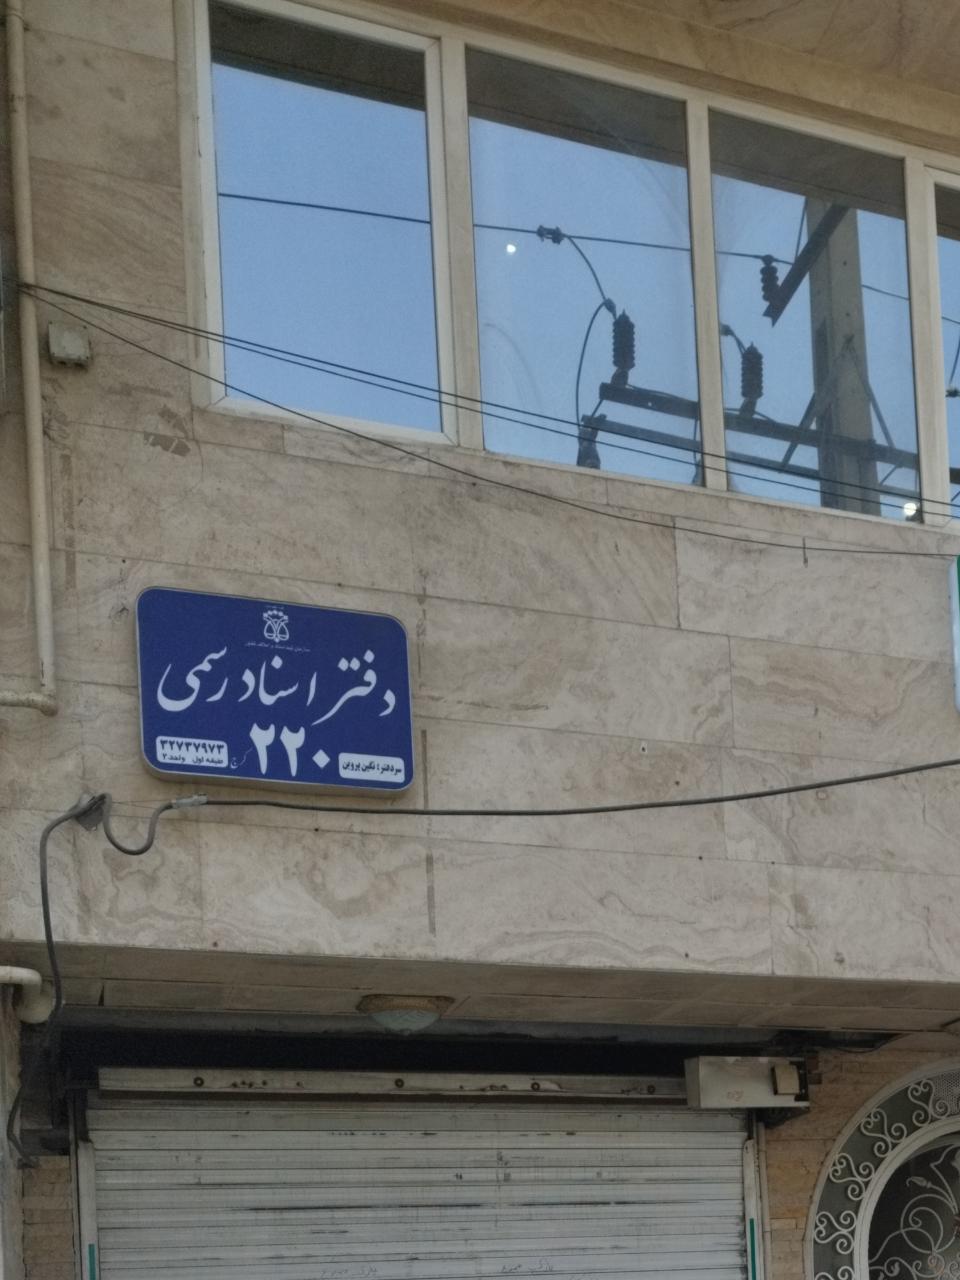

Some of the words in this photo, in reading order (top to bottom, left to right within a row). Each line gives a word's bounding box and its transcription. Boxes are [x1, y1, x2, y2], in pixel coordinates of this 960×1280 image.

[157, 646, 229, 712] رسمی
[238, 655, 317, 706] اسناد
[311, 649, 396, 726] دفتر
[249, 722, 331, 777] ۲۲۰
